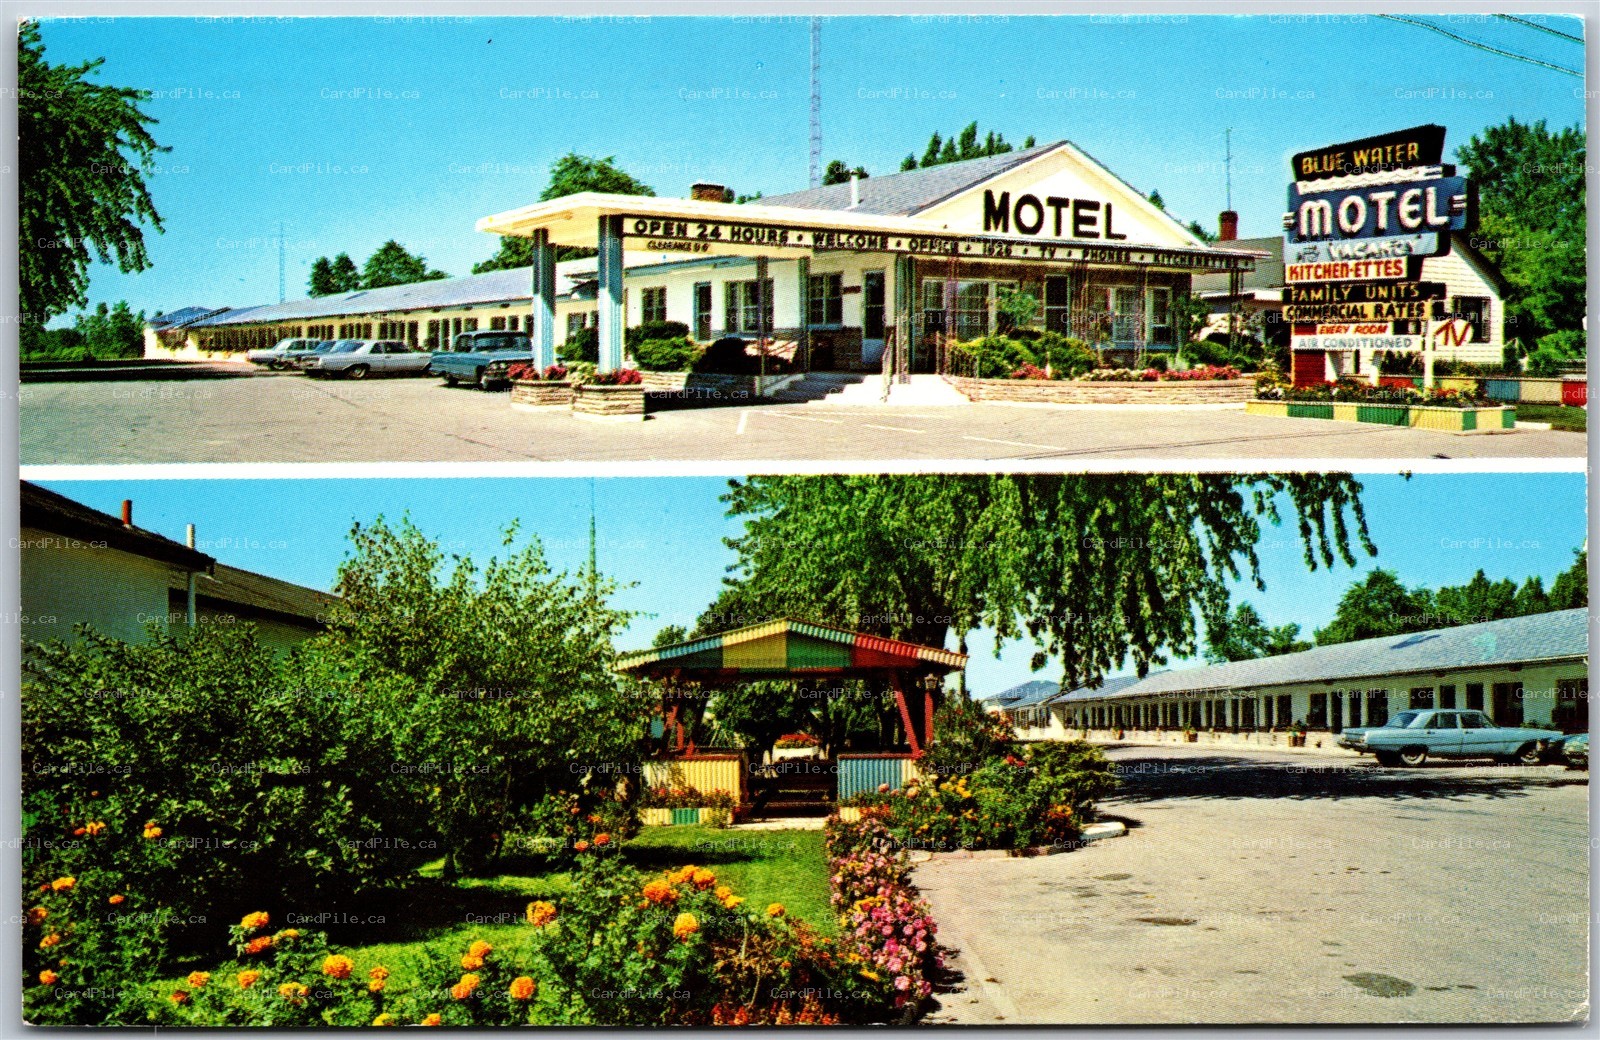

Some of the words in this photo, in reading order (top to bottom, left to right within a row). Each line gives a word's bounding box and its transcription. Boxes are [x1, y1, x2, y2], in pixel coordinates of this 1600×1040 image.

[1301, 152, 1345, 175] BLUE
[1353, 142, 1419, 167] WATER
[983, 189, 1126, 240] MOTEL
[1299, 186, 1449, 236] MOTEL
[634, 219, 687, 237] OPEN
[697, 223, 721, 239] 24
[730, 226, 788, 244] HOURS
[813, 231, 889, 249] WELCOME
[1292, 284, 1350, 300] FAMILY
[1366, 284, 1419, 299] UNITS
[1286, 304, 1367, 321] COMMERCIAL
[1374, 302, 1425, 319] RATES
[1298, 338, 1318, 348] AIR
[1323, 337, 1412, 348] CONDITIONED
[1353, 324, 1388, 334] ROOM
[1434, 318, 1471, 347] TV
